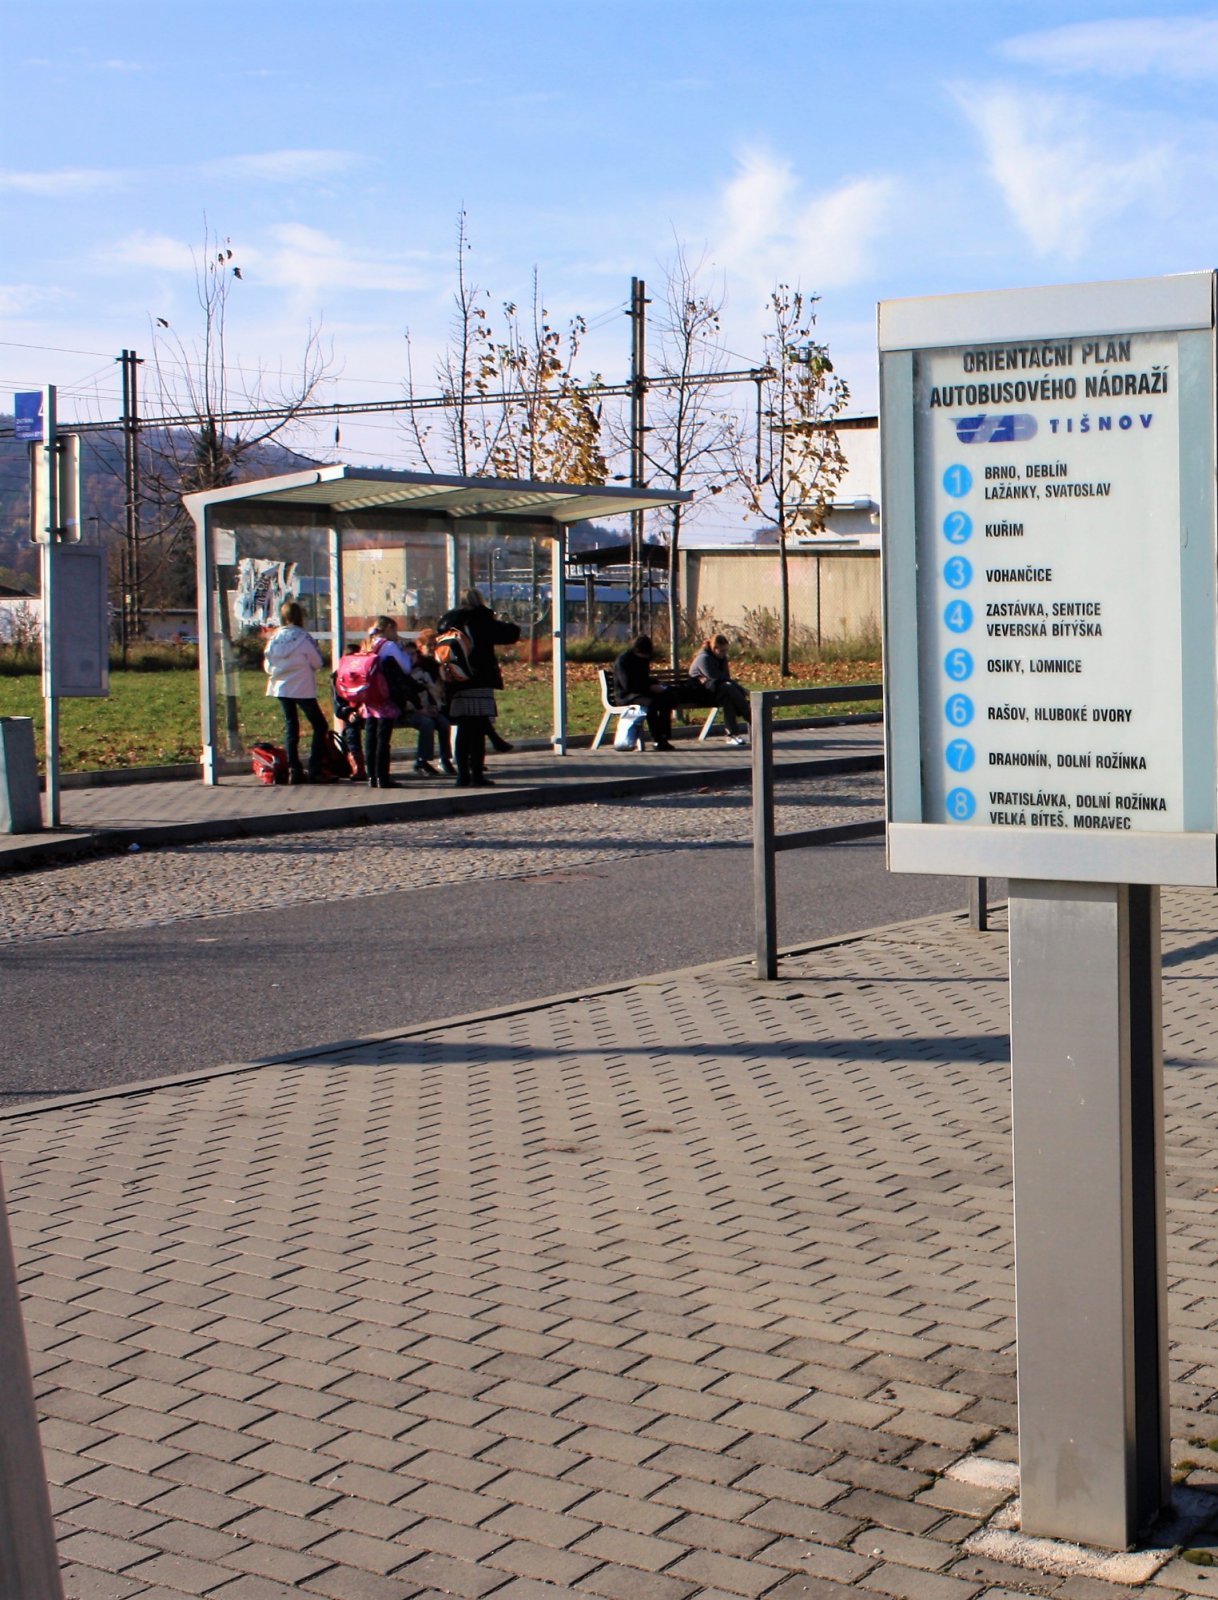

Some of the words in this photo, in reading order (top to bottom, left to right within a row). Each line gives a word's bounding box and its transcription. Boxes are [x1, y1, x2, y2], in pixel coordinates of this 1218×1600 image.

[930, 374, 1077, 408] AUTOBUSOVÉHO
[1085, 366, 1168, 397] NÁDRAŽÍ
[1049, 413, 1153, 434] TIŠNOV
[984, 464, 1021, 480] BRNO,
[1025, 460, 1067, 478] DEBLÍN
[950, 469, 962, 495] 1
[984, 480, 1041, 500] LAŽÁNKY,
[1045, 482, 1111, 498] SVATOSLAV
[950, 514, 965, 541] 2
[985, 520, 1024, 538] KUŘIM
[950, 560, 966, 587] 3
[986, 565, 1052, 583] VOHANČICE
[949, 604, 965, 627] 4
[986, 600, 1048, 618] ZASTÁVKA,
[1052, 602, 1101, 617] SENTICE
[986, 619, 1048, 637] VEVERSKÁ
[1052, 618, 1102, 637] BÍTÝŠKA
[952, 653, 967, 678] 5
[987, 659, 1025, 675] OSIKY,
[1029, 659, 1082, 674] LOMNICE
[952, 698, 967, 722] 6
[987, 703, 1030, 723] RAŠOV,
[1035, 704, 1088, 722] HLUBOKÉ
[1093, 708, 1132, 723] DVORY
[954, 744, 968, 770] 7
[988, 750, 1052, 768] DRAHONÍN,
[1056, 751, 1091, 768] DOLNÍ
[1096, 751, 1147, 770] ROŽÍNKA
[955, 791, 969, 817] 8
[989, 790, 1072, 810] VRATISLÁVKA,
[1076, 791, 1111, 809] DOLNÍ
[1115, 793, 1167, 812] ROŽÍNKA
[990, 809, 1027, 827] VELKÁ
[1073, 814, 1131, 830] MORAVEC
